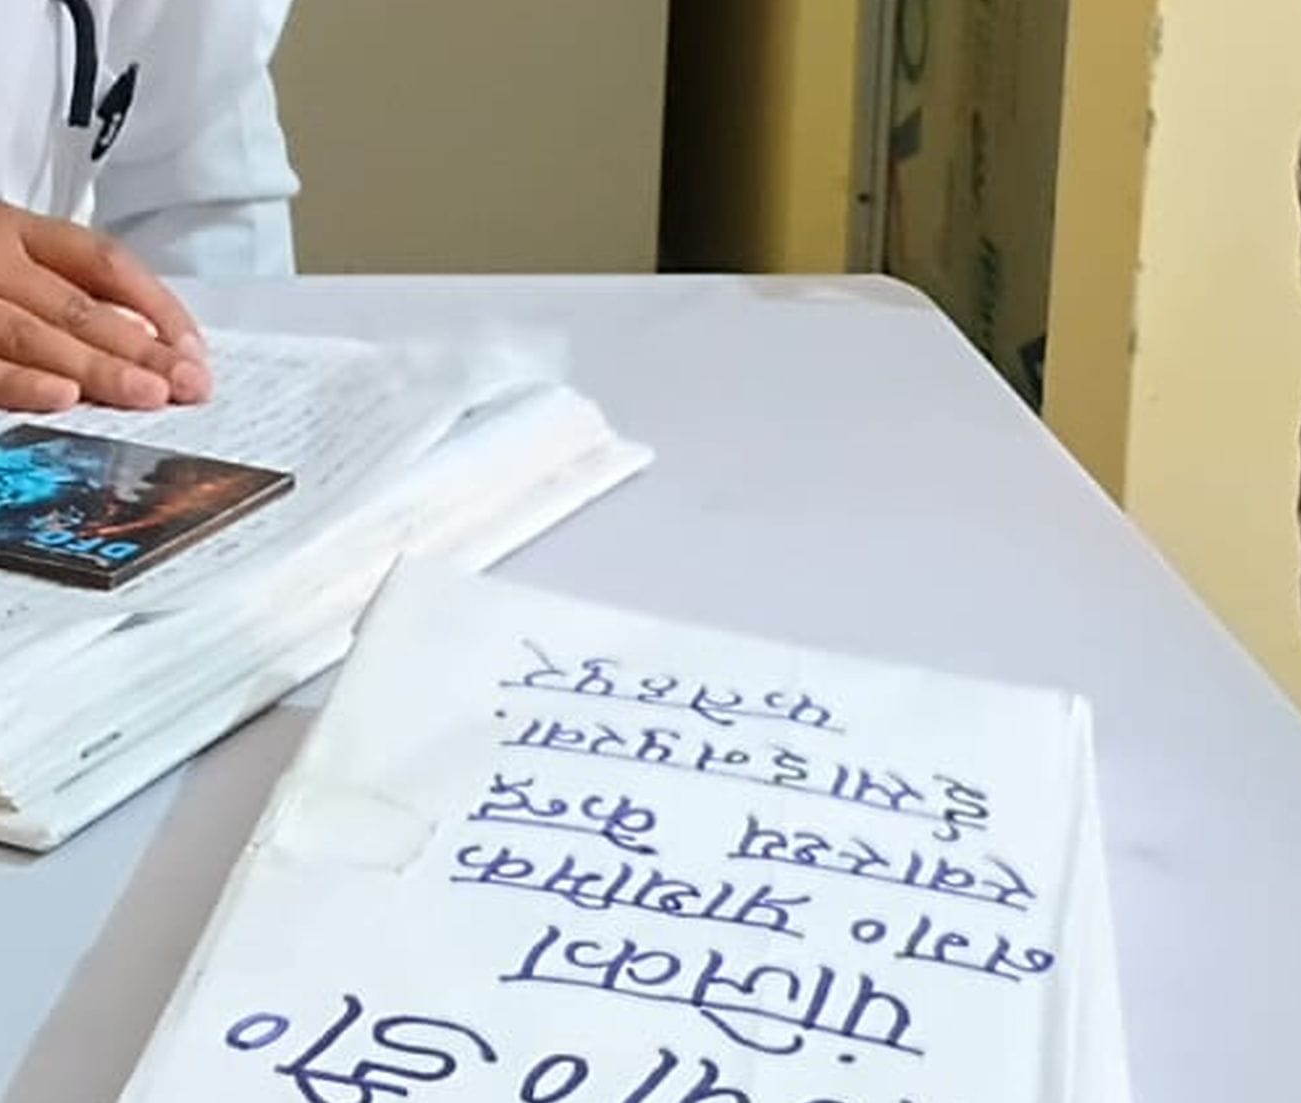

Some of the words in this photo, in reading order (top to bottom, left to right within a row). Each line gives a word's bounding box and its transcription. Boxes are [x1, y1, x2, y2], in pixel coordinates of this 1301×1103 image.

[500, 638, 846, 734] फतेहपुर
[450, 843, 812, 938] प्राथमिक
[500, 925, 925, 1062] पंजिका
